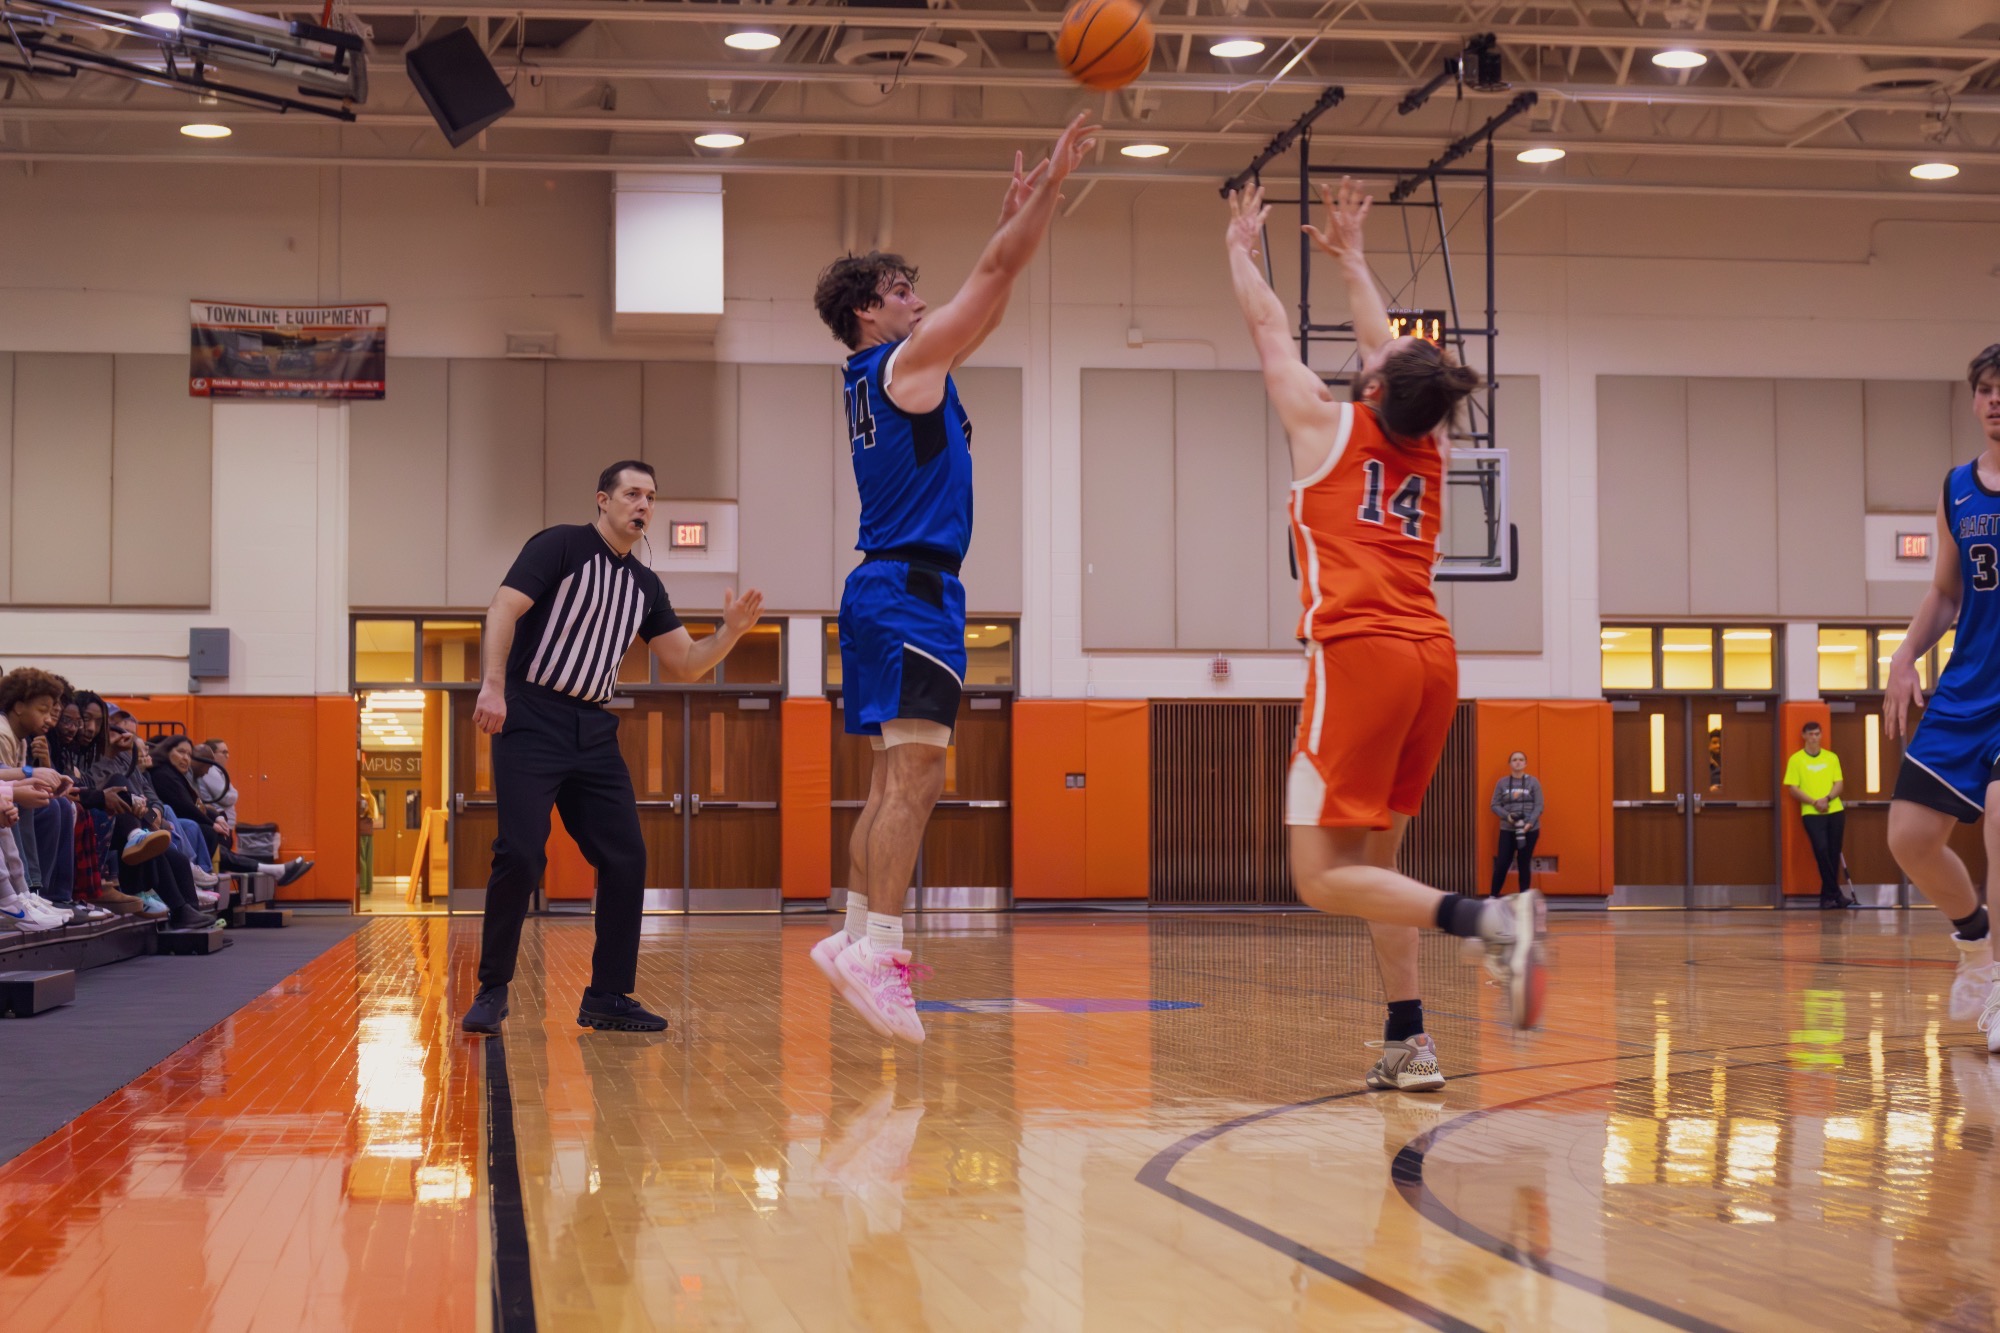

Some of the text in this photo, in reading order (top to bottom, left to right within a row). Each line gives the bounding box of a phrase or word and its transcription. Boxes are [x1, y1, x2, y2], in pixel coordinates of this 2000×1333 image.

[205, 306, 372, 325] TOWNLINE EQUIPMENT
[1357, 458, 1426, 540] 14
[677, 525, 702, 544] EXIT
[1904, 536, 1926, 555] EXIT
[1969, 544, 1999, 591] 3
[406, 757, 422, 772] ST
